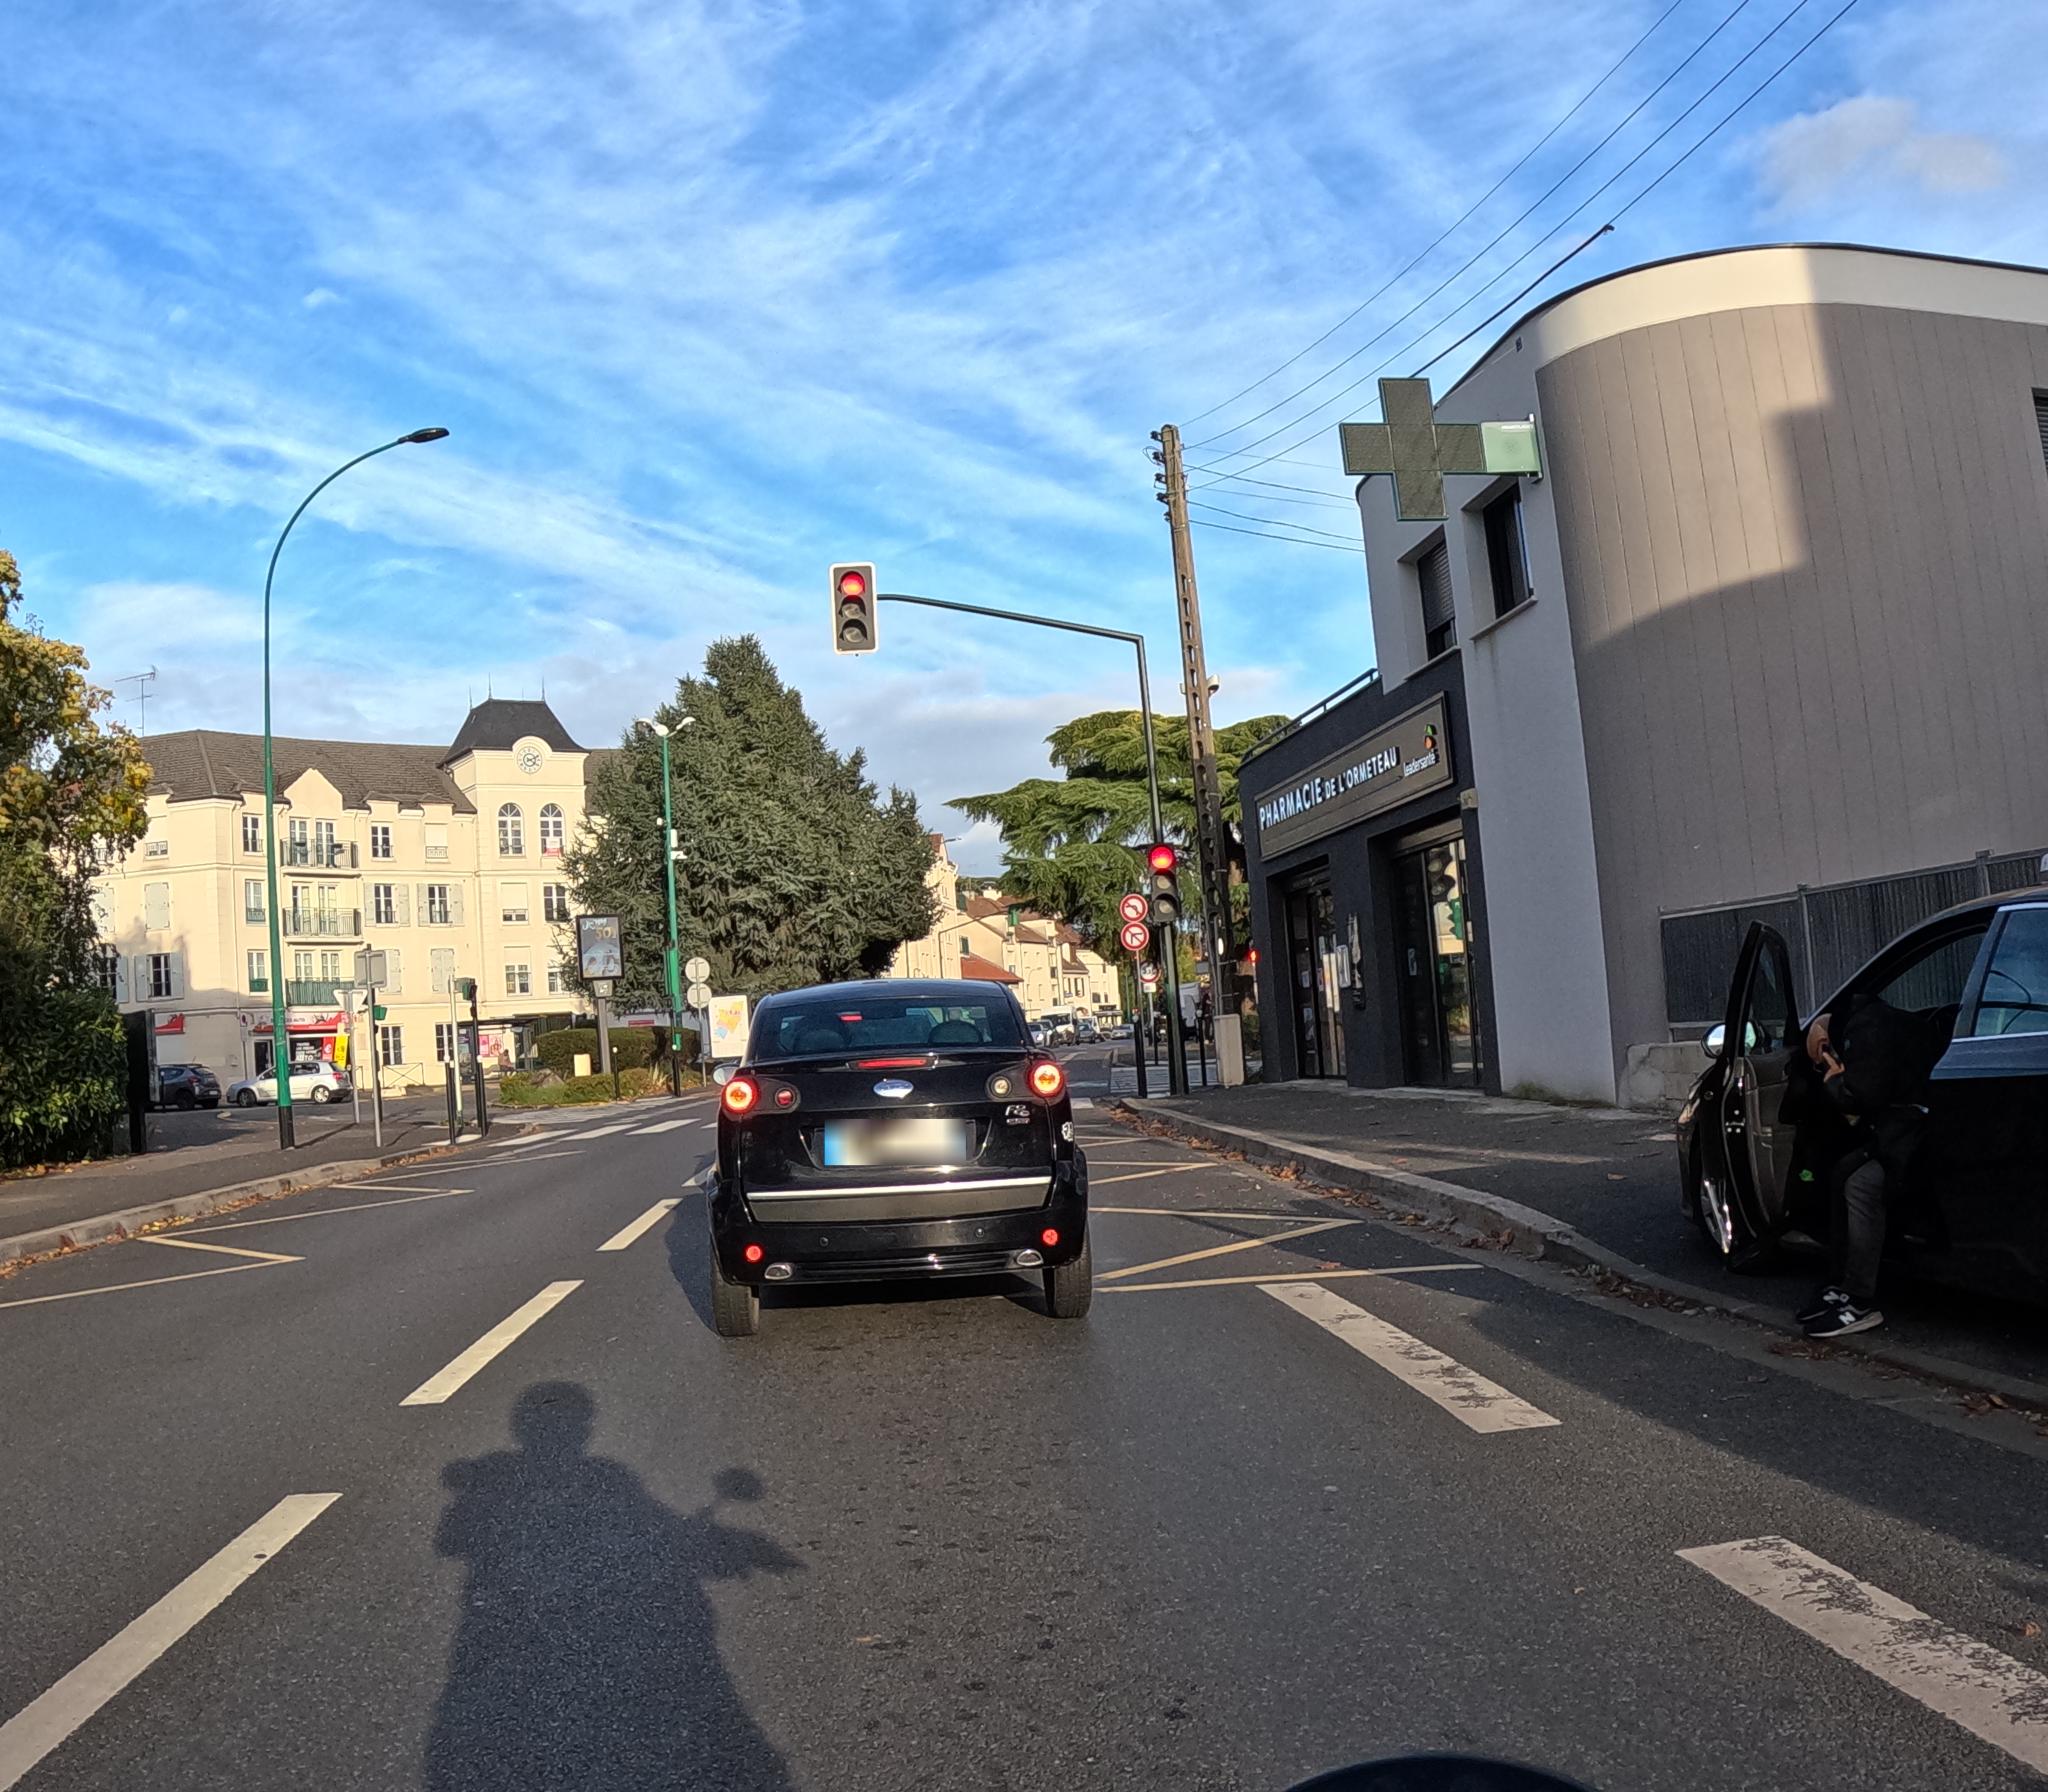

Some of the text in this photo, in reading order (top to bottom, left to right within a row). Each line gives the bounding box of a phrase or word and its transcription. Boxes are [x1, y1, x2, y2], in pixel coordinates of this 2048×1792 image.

[1259, 747, 1397, 831] PHARMACIE DE L'ORMETEAU
